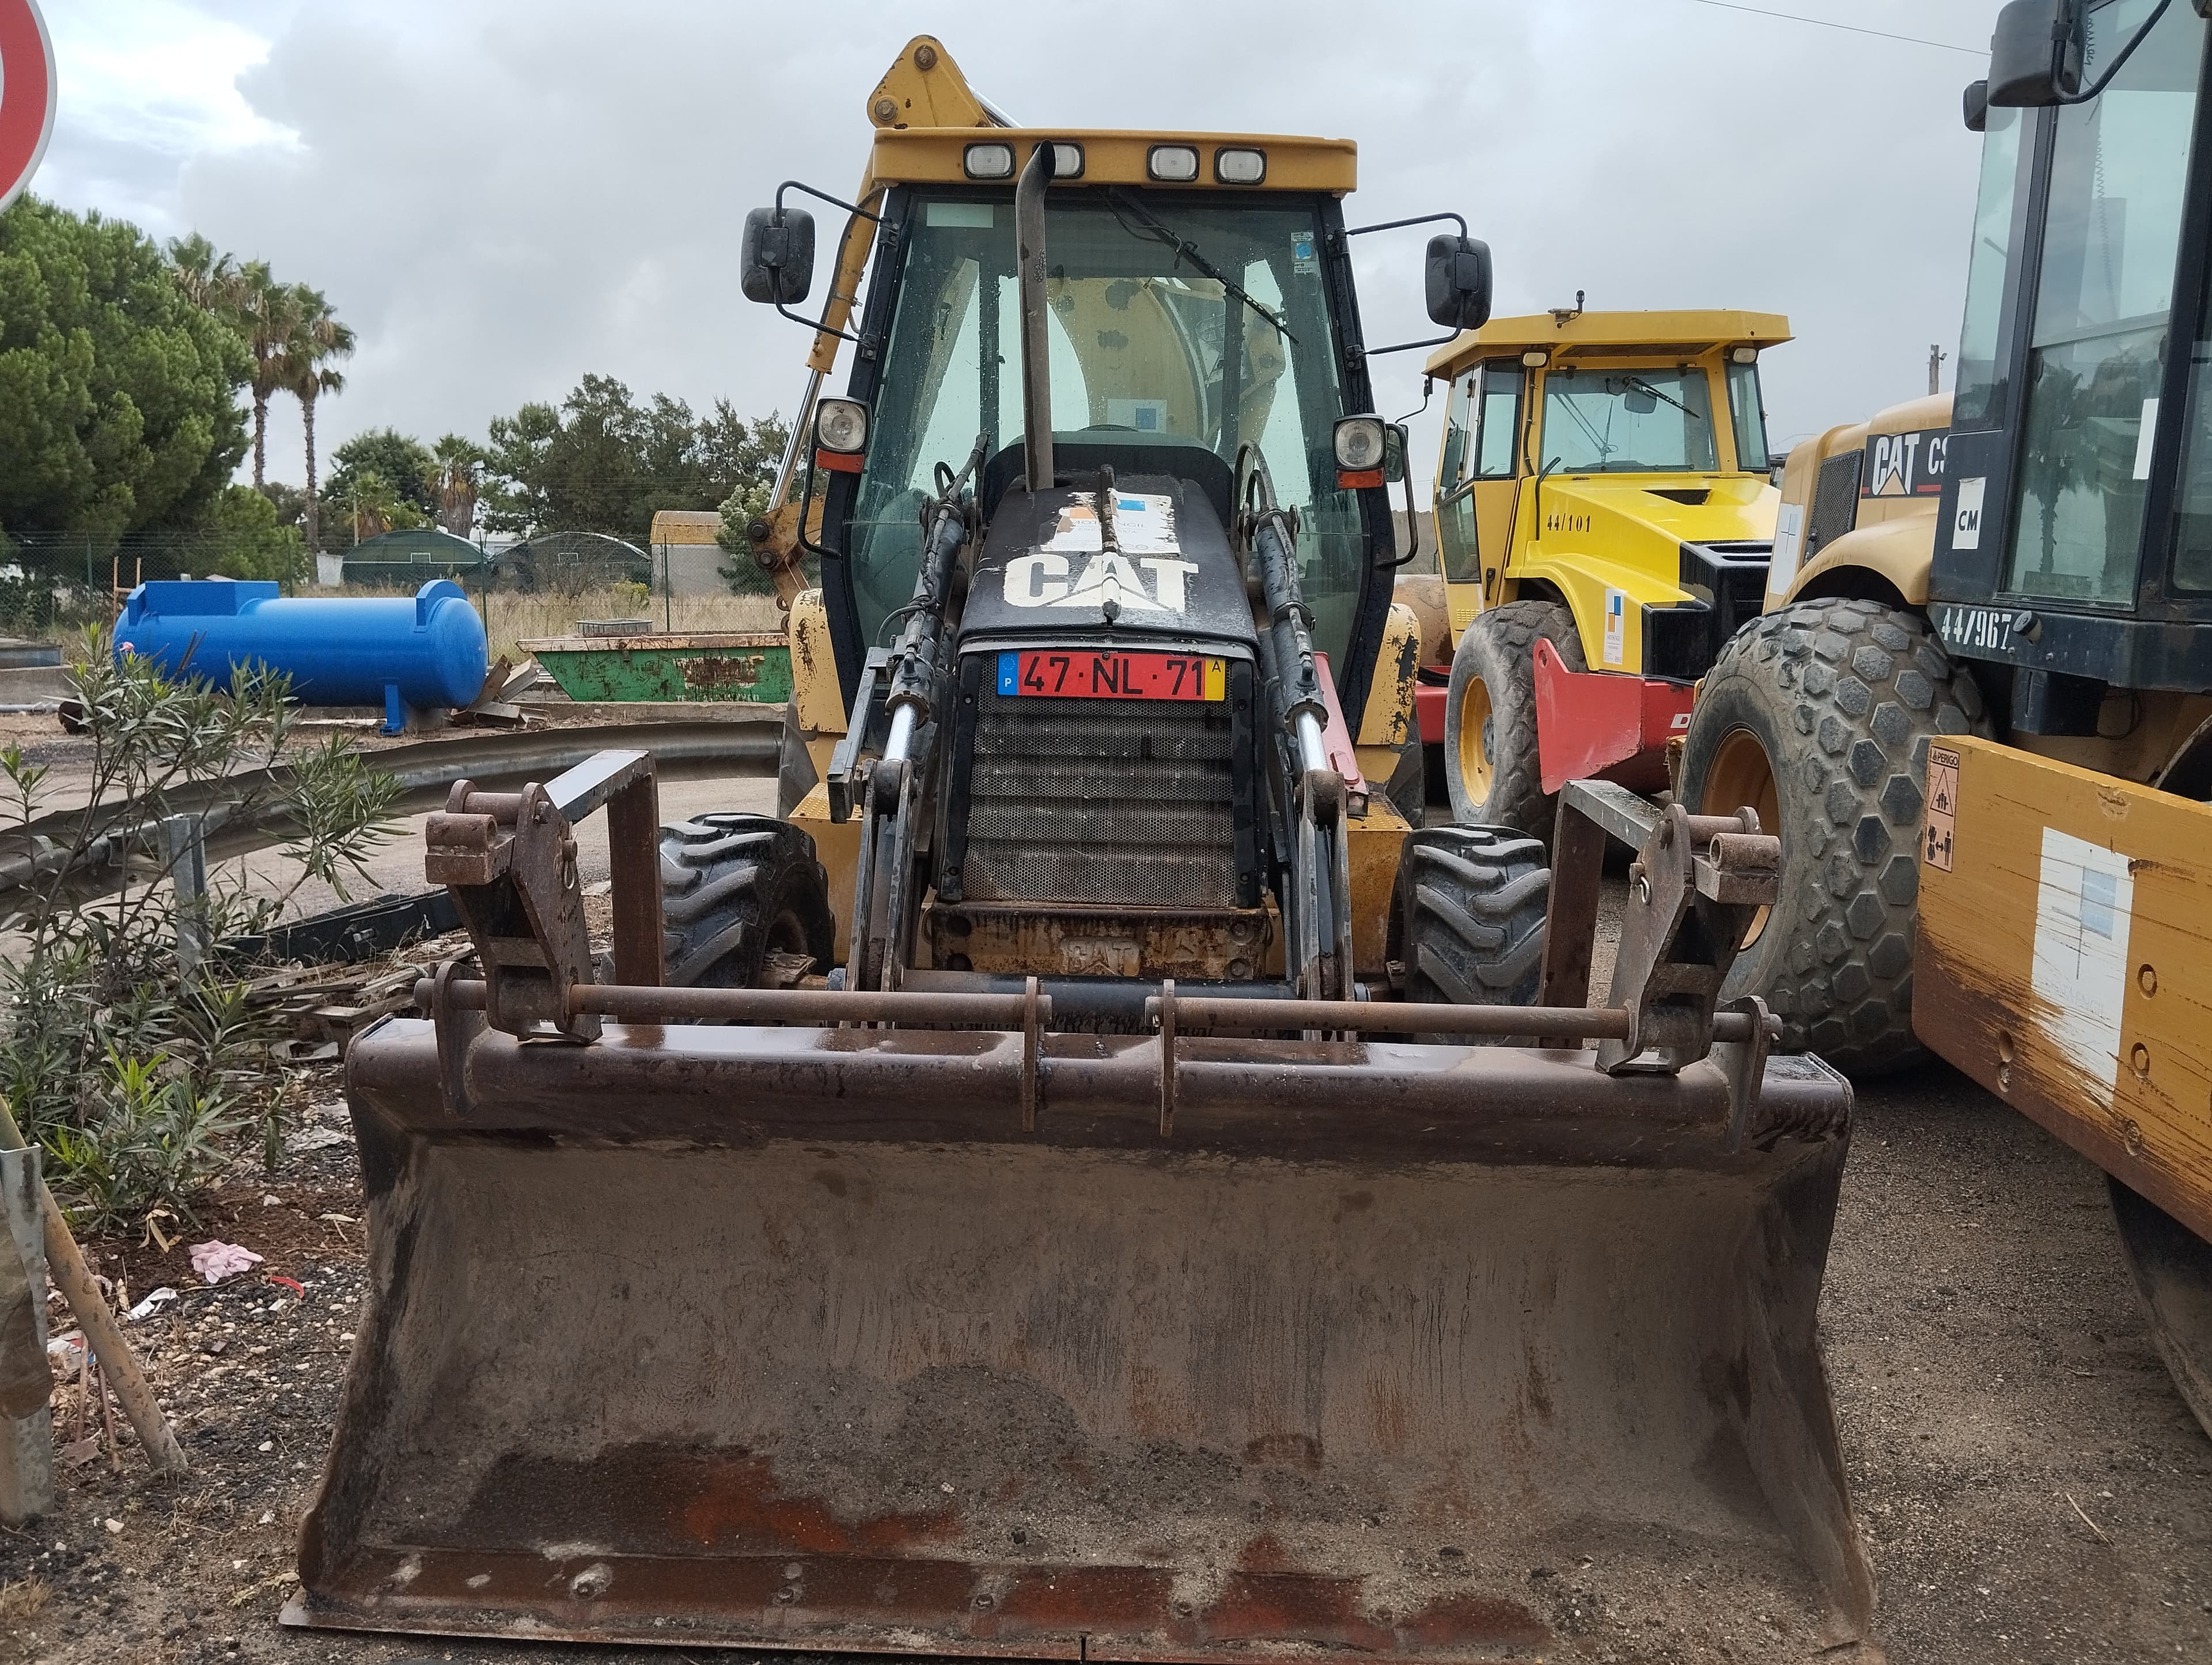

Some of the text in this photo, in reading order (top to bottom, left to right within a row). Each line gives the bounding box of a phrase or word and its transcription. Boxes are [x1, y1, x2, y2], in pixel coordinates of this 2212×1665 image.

[1872, 434, 1920, 495] CAT
[1547, 513, 1590, 532] 44/101
[1959, 510, 1978, 531] CM
[1003, 552, 1199, 613] CAT
[1941, 607, 2012, 650] 44/967
[1004, 677, 1012, 688] P
[1211, 661, 1221, 673] A
[1937, 752, 1959, 766] PERIGO
[1067, 939, 1131, 976] CAT
